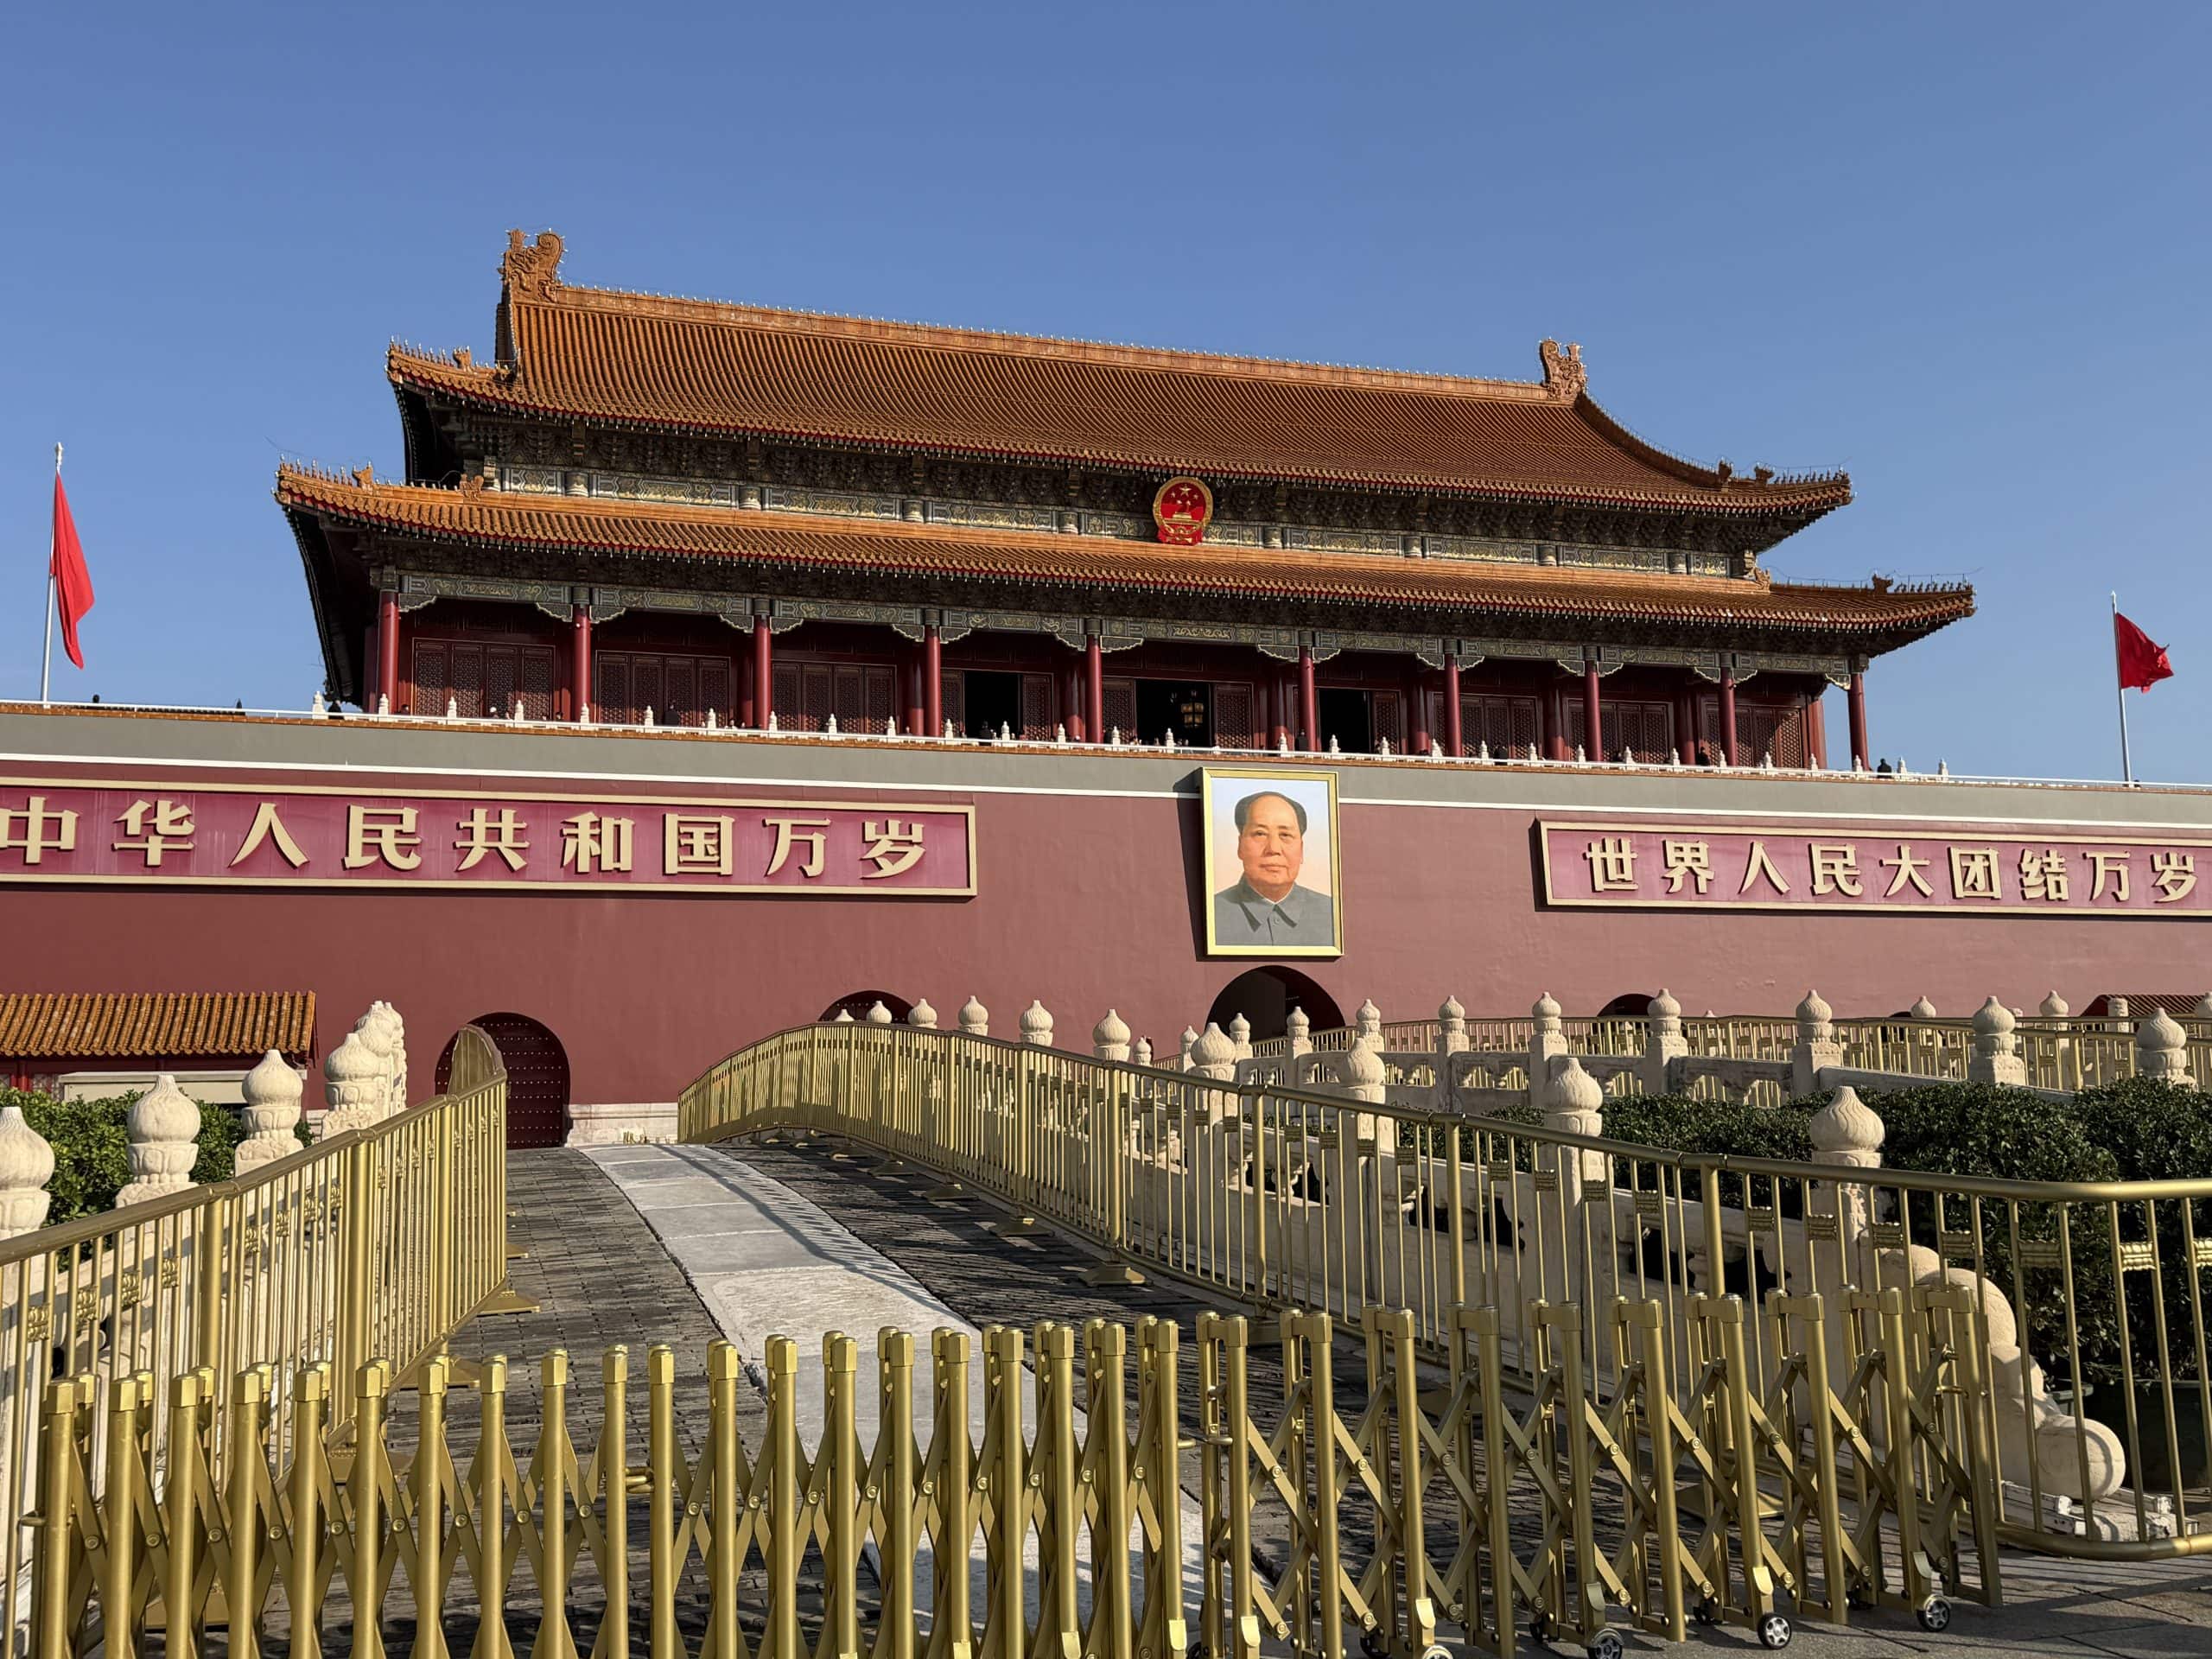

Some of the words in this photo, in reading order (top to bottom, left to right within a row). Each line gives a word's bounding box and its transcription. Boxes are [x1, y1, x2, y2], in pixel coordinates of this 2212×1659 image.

[0, 796, 926, 880] 中华人民共和国万岁
[1585, 837, 2198, 903] 世界人民大团结万岁
